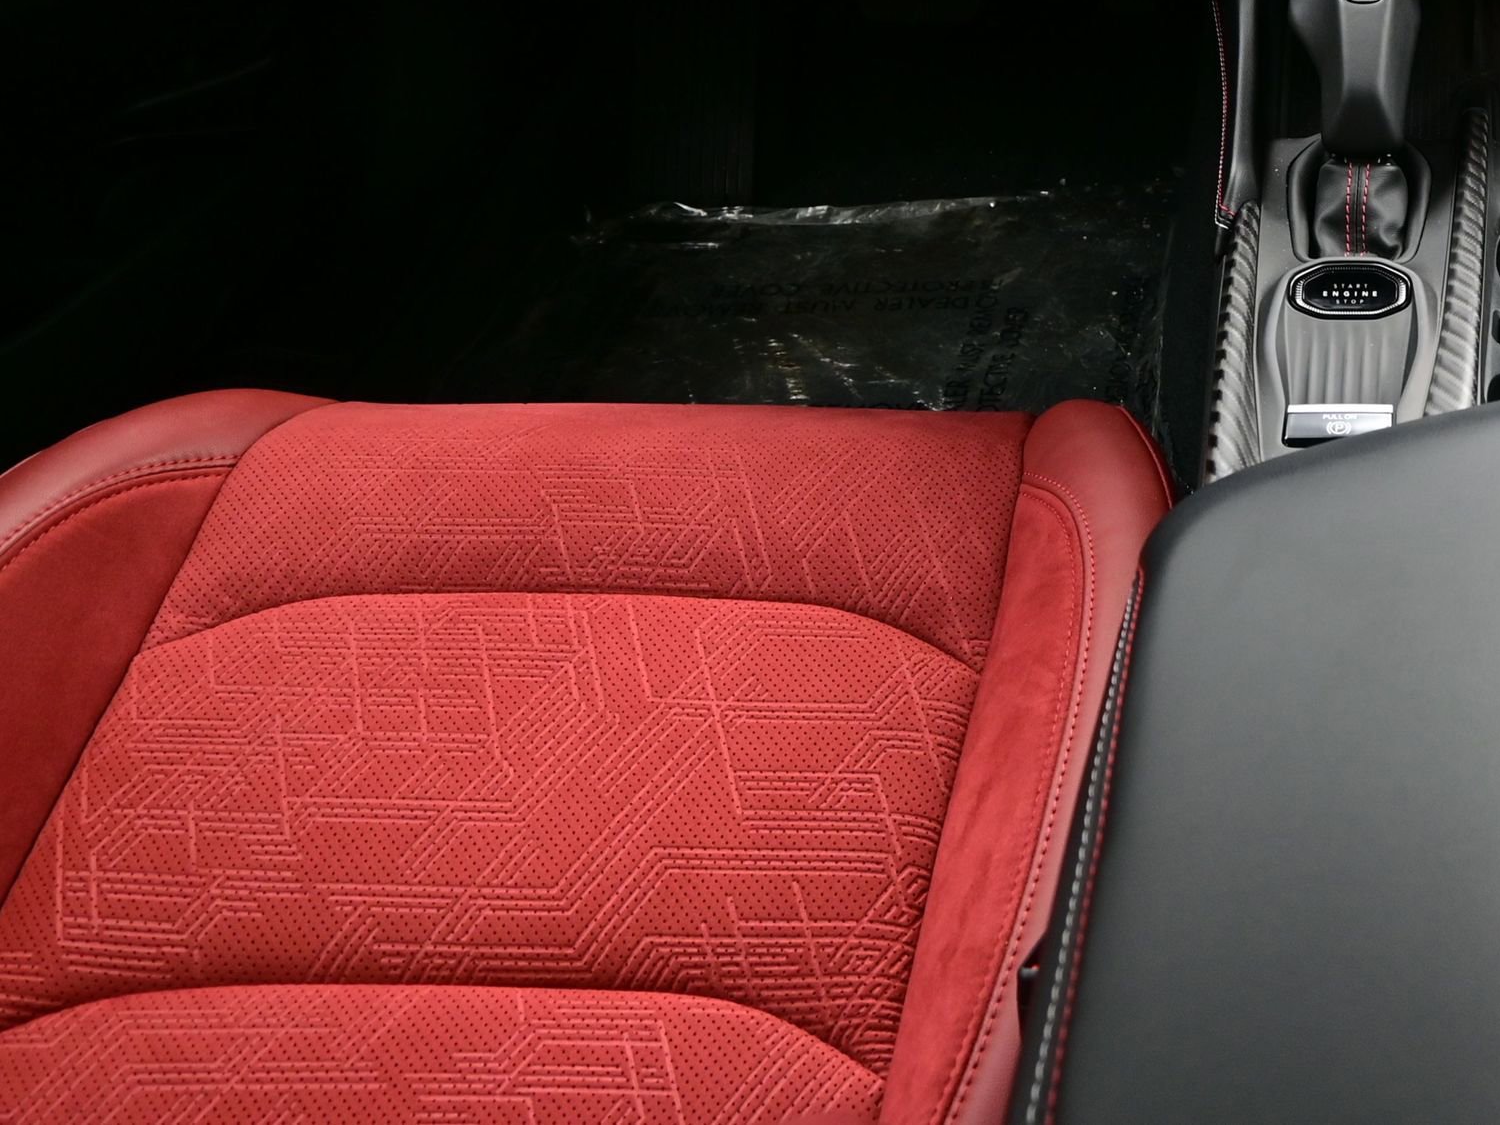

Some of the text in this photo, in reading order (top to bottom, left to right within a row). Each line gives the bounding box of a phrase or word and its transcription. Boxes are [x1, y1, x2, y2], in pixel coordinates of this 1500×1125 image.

[1322, 290, 1378, 298] ENGINE
[783, 299, 857, 315] MUST
[874, 296, 969, 312] DEALER
